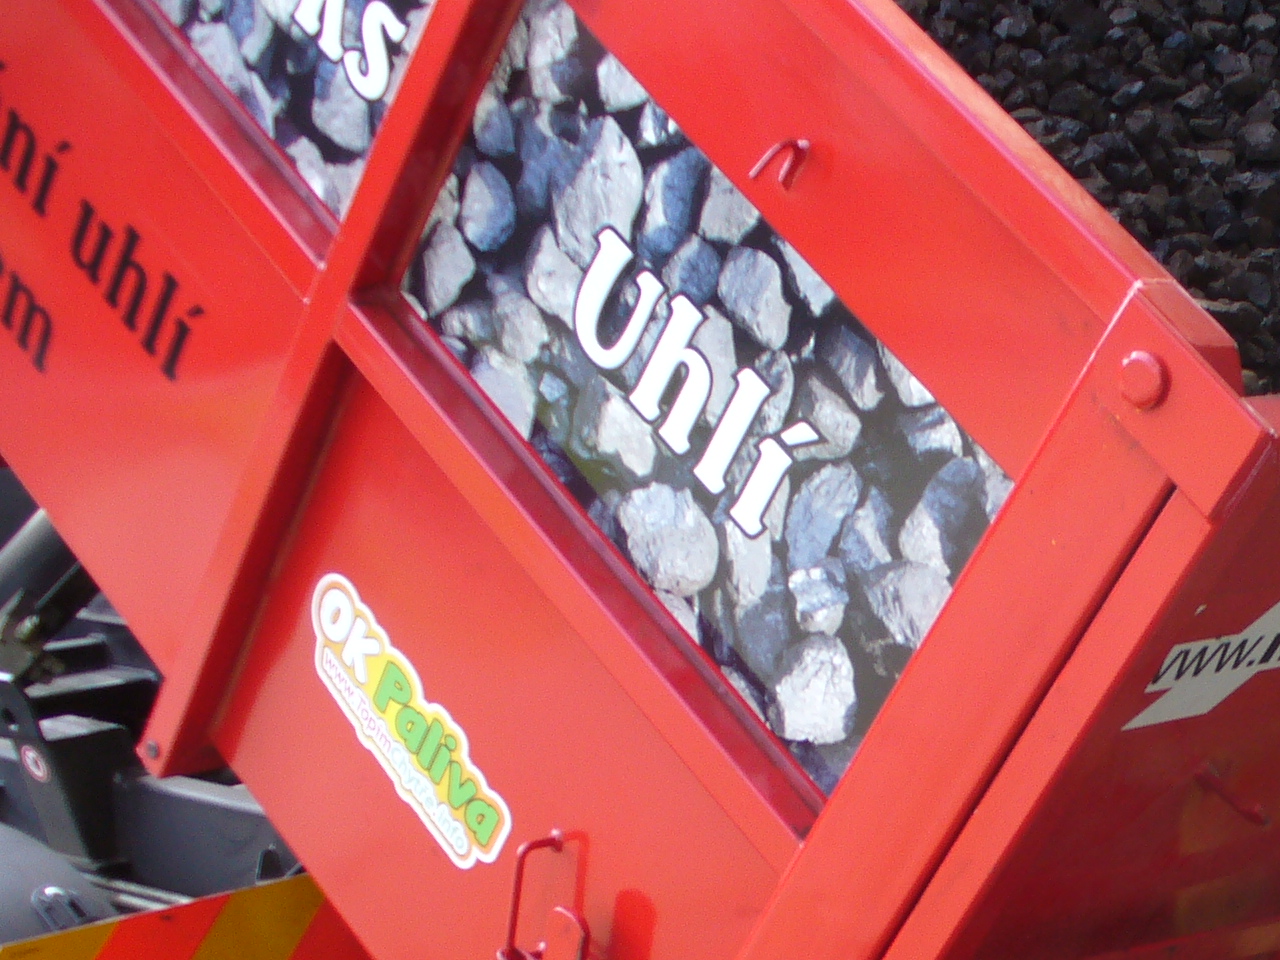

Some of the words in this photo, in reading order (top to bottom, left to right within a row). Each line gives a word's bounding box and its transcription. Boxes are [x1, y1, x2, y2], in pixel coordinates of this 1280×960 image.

[0, 107, 72, 218] ní
[69, 199, 205, 381] uhlí
[0, 265, 53, 374] m
[574, 225, 820, 540] Uhlí
[319, 587, 381, 683] OK
[373, 659, 500, 848] Paliva
